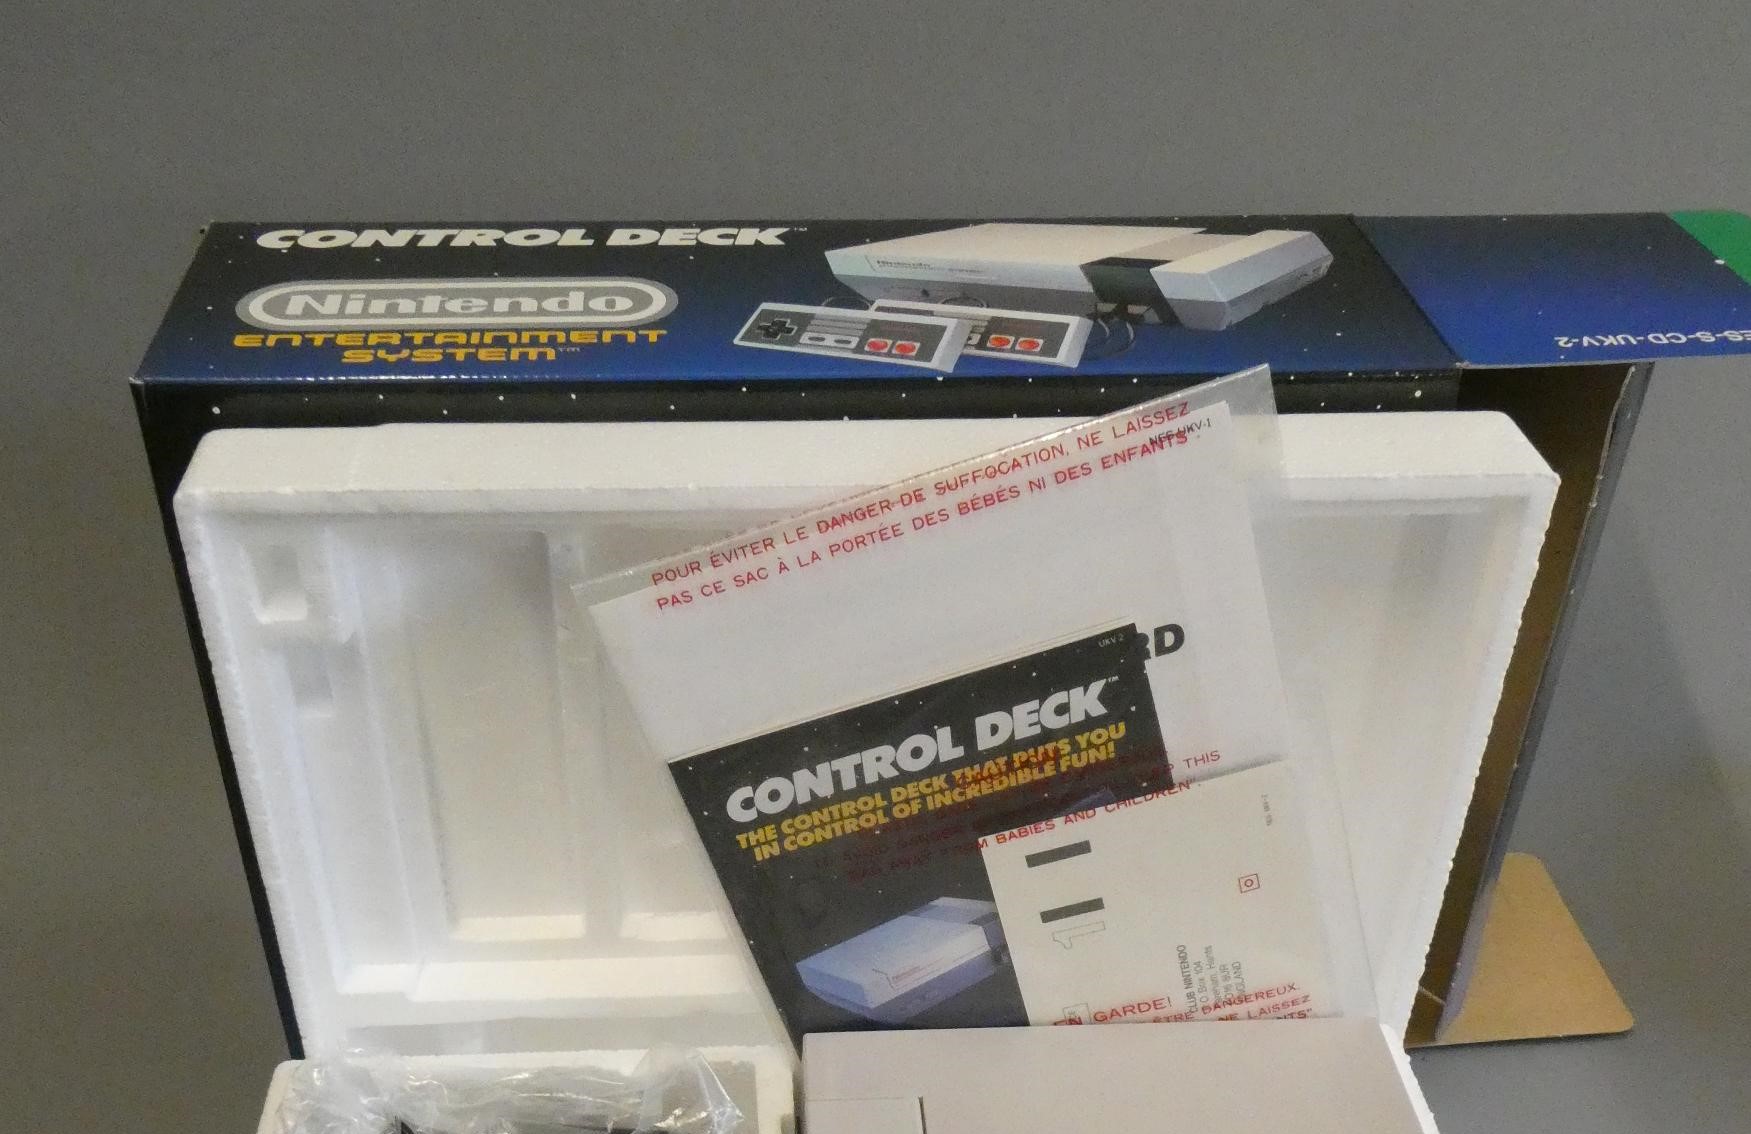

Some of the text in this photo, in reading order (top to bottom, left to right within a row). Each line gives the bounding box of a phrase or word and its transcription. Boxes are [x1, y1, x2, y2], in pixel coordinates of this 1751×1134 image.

[255, 229, 595, 249] CONTROL
[285, 291, 634, 315] Nintendo
[233, 329, 667, 348] ENTERTAINMENT
[651, 401, 1191, 586] POUR ÉVITER LE DANGER DE SUFFOCATION, NE LAISSEZ
[657, 590, 693, 611] PAS
[700, 580, 727, 598] CE
[733, 567, 770, 588] SAC
[778, 556, 791, 575] À
[796, 550, 822, 568] LA
[828, 521, 905, 557] PORTÉE
[911, 508, 950, 531] DES
[957, 481, 1021, 517] BÉBÉS
[1028, 476, 1047, 494] NI
[1054, 462, 1093, 486] DES
[726, 726, 965, 823] CONTROL
[1183, 750, 1221, 770] THIS
[736, 824, 778, 849] THE
[781, 791, 888, 835] CONTROL
[890, 773, 948, 803] DECK
[951, 756, 1008, 783] THAT
[1012, 737, 1072, 769] PUTS
[1075, 721, 1126, 749] YOU
[754, 842, 781, 861] IN
[783, 809, 890, 851] CONTROL
[892, 799, 922, 819] OF
[926, 760, 1057, 811] INCREDIBLE
[1060, 741, 1116, 772] FUN!
[995, 819, 1056, 845] BABIES
[1064, 808, 1097, 826] AND
[1175, 944, 1194, 990] NINTENDO
[1200, 982, 1298, 1015] DANGEREUX
[1247, 994, 1311, 1020] LAISSEZ
